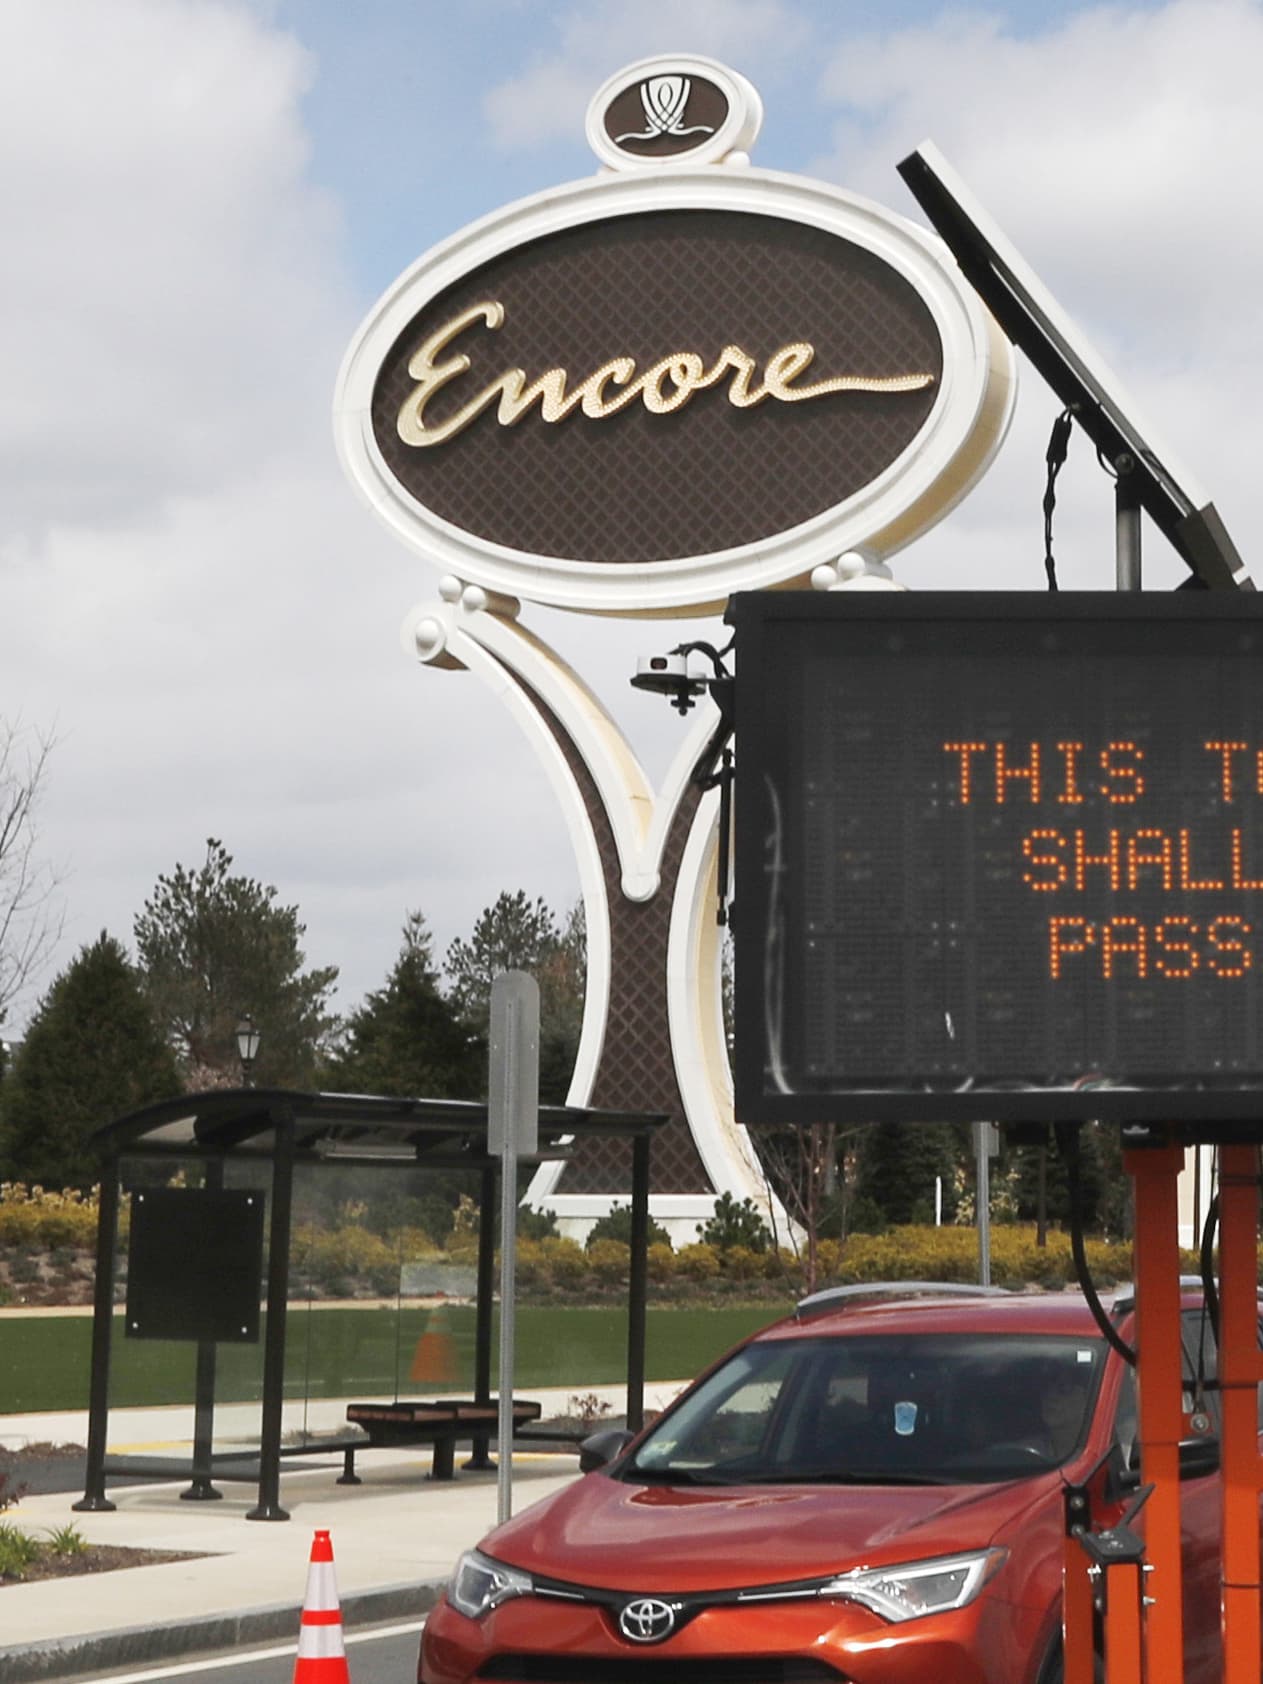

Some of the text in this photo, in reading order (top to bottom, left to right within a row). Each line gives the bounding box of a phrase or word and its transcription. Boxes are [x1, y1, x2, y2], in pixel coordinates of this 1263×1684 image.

[396, 301, 934, 447] Encore
[943, 742, 1144, 804] THIS
[1049, 915, 1252, 979] PASS
